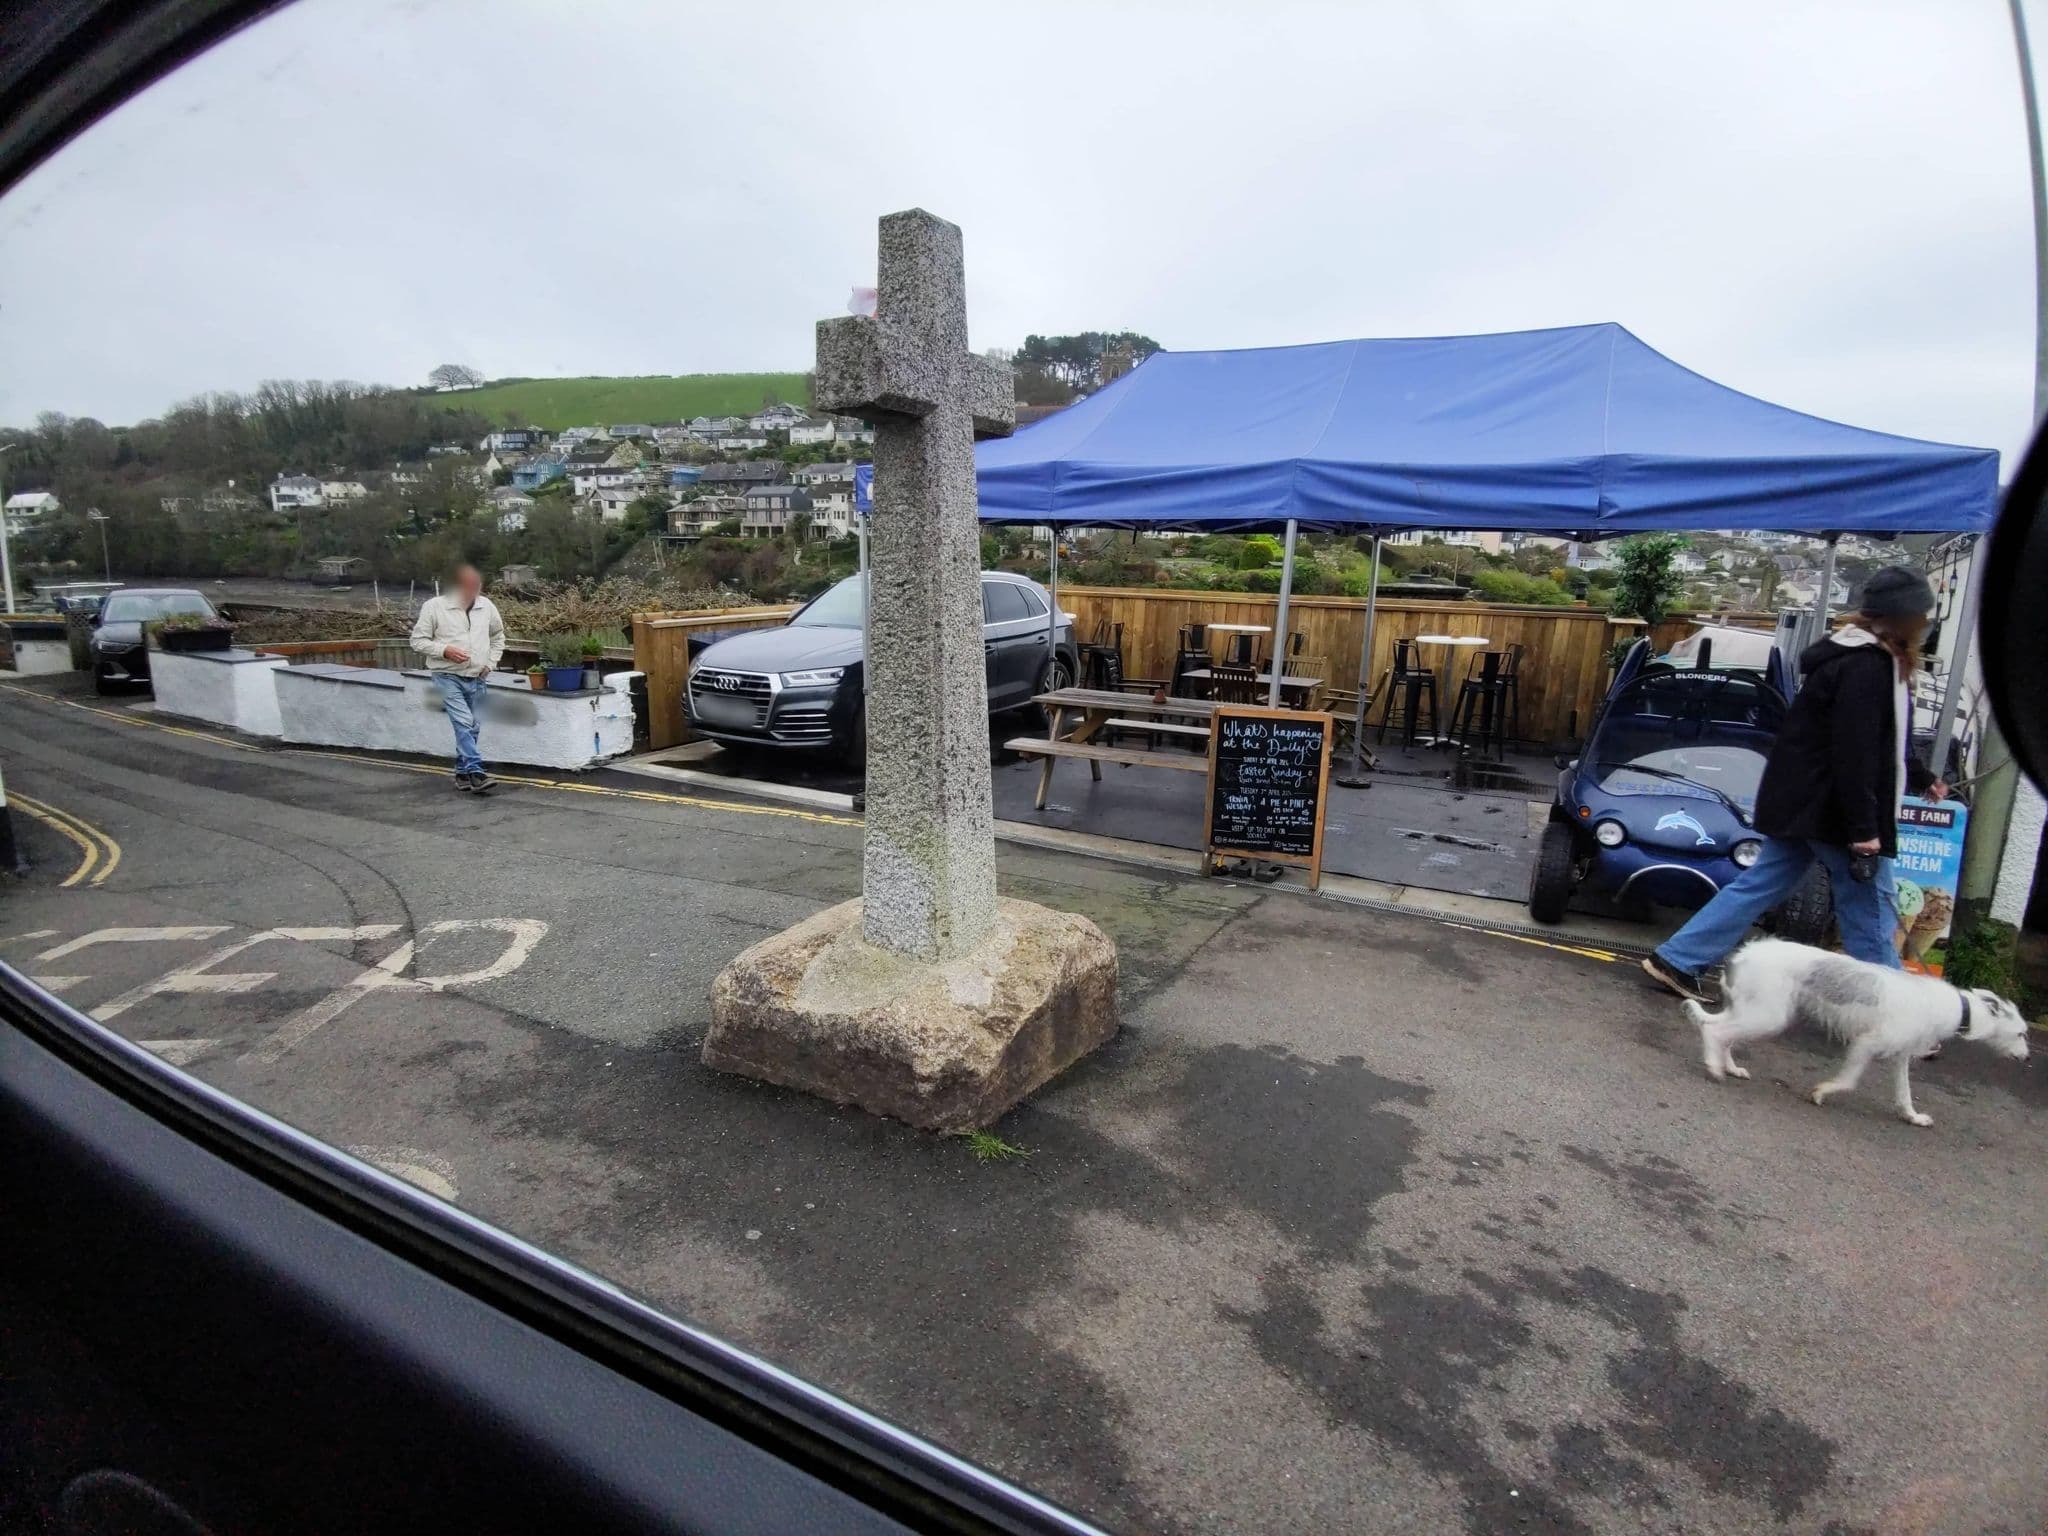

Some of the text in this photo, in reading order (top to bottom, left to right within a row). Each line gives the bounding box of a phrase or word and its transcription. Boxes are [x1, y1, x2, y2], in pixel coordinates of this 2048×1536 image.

[1675, 673, 1727, 682] BLONDERS
[1223, 738, 1237, 748] at
[1242, 738, 1260, 749] the
[1273, 723, 1322, 750] happening
[1238, 764, 1307, 788] Easter Sunday
[1270, 799, 1280, 807] PIE
[1289, 799, 1305, 808] PINT
[1921, 810, 1950, 824] FARM
[1893, 853, 1942, 872] CREAM
